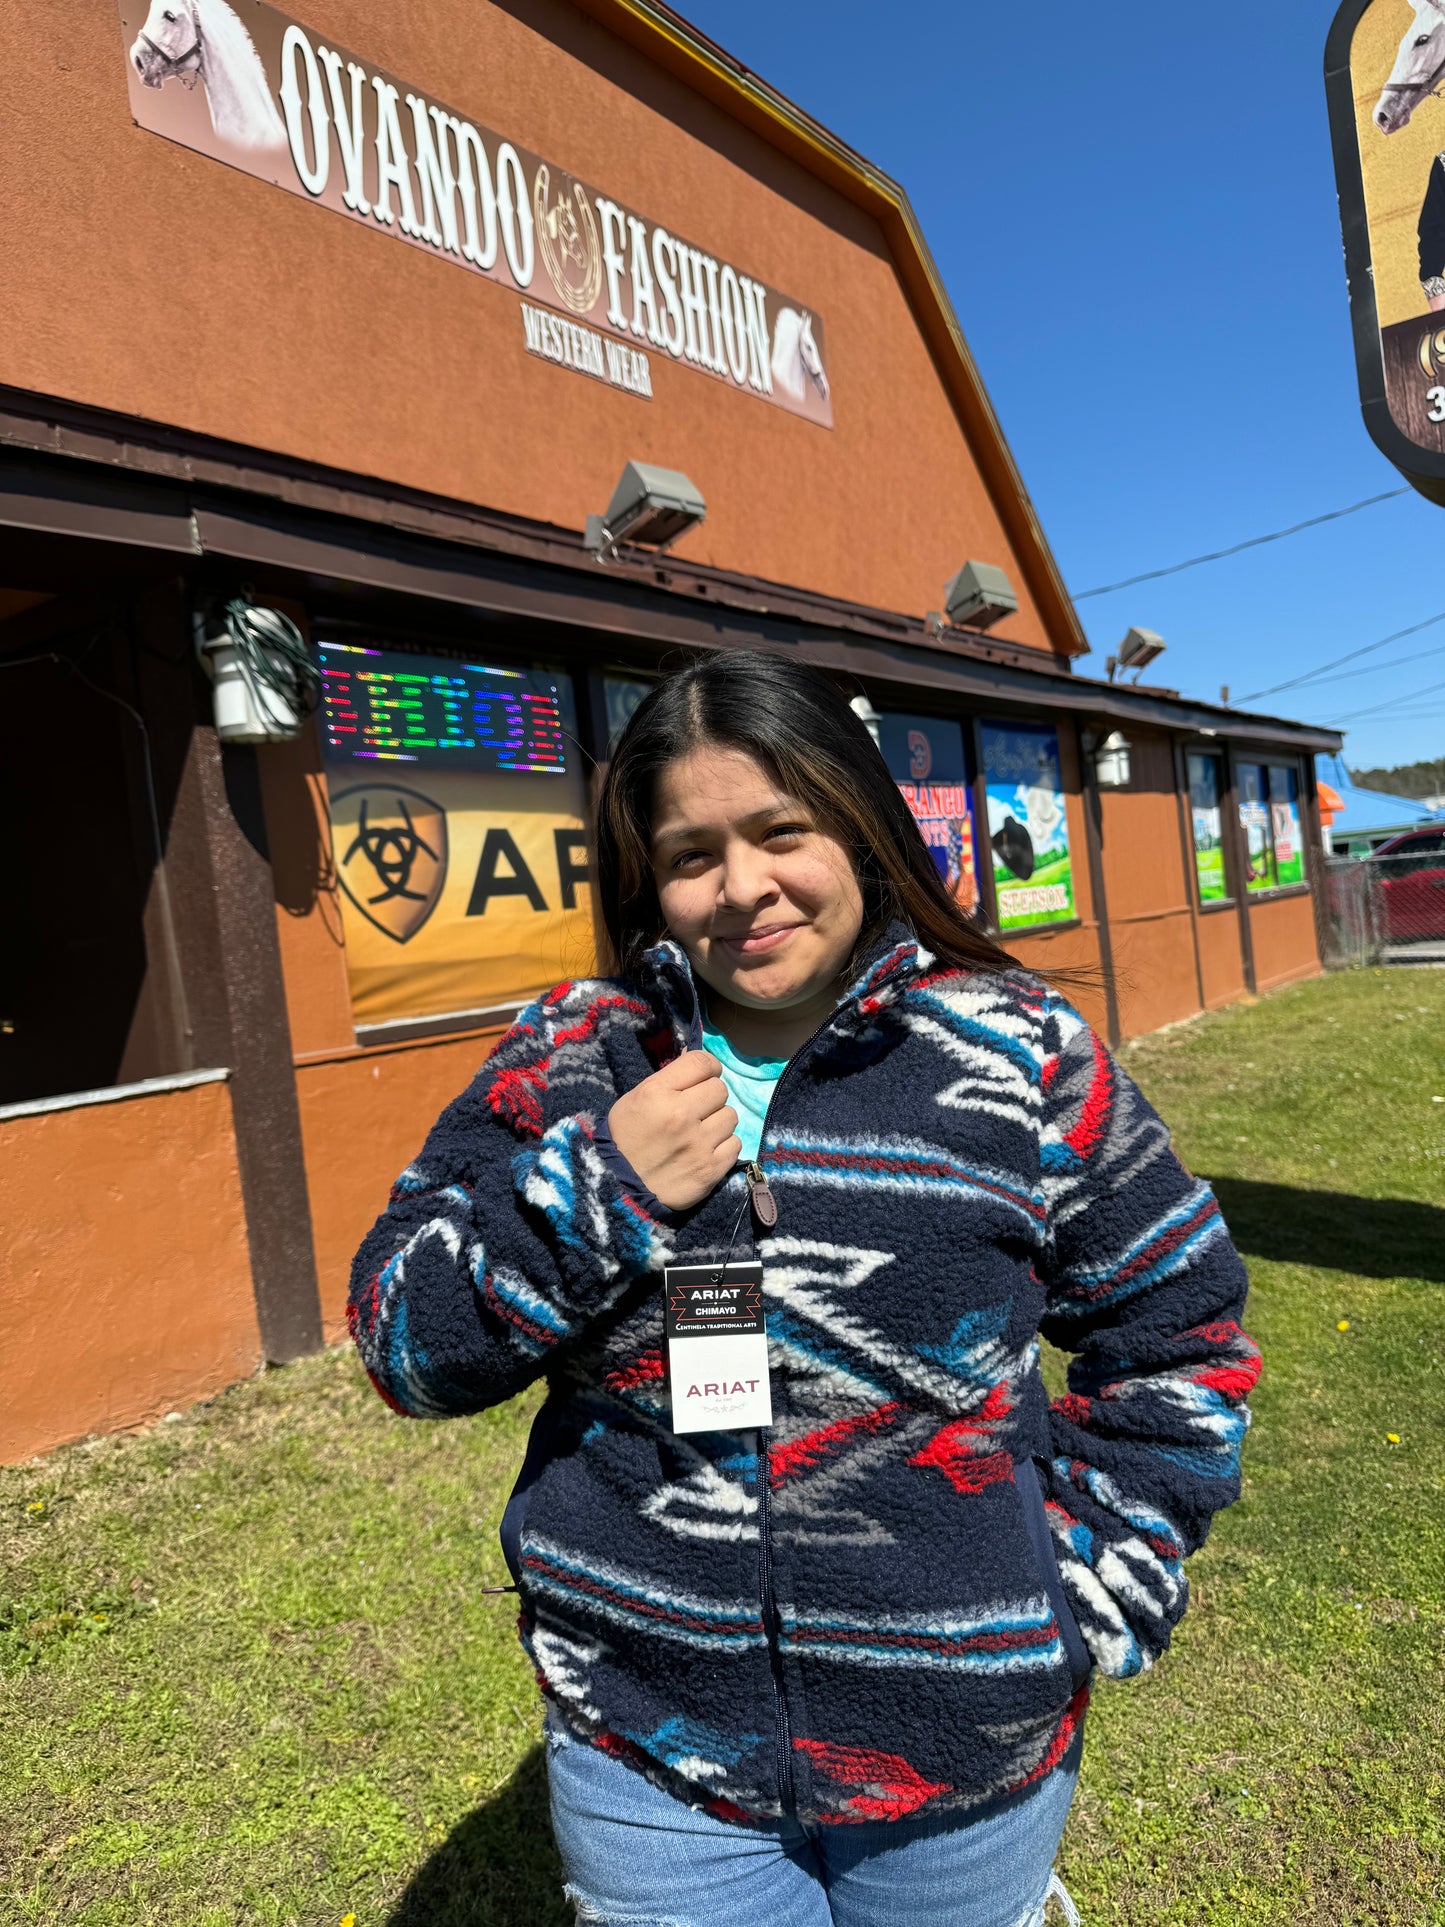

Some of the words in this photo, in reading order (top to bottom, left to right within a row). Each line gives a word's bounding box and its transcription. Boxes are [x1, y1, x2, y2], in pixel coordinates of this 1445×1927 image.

[280, 25, 534, 289] OVANDO
[595, 197, 773, 396] FASHION
[520, 301, 605, 379] WESTERN
[602, 337, 653, 399] WEAR
[1000, 885, 1068, 917] STETSON
[690, 1289, 740, 1301] ARIAT
[695, 1306, 737, 1316] CHIMAYO
[686, 1379, 760, 1398] ARIAT
